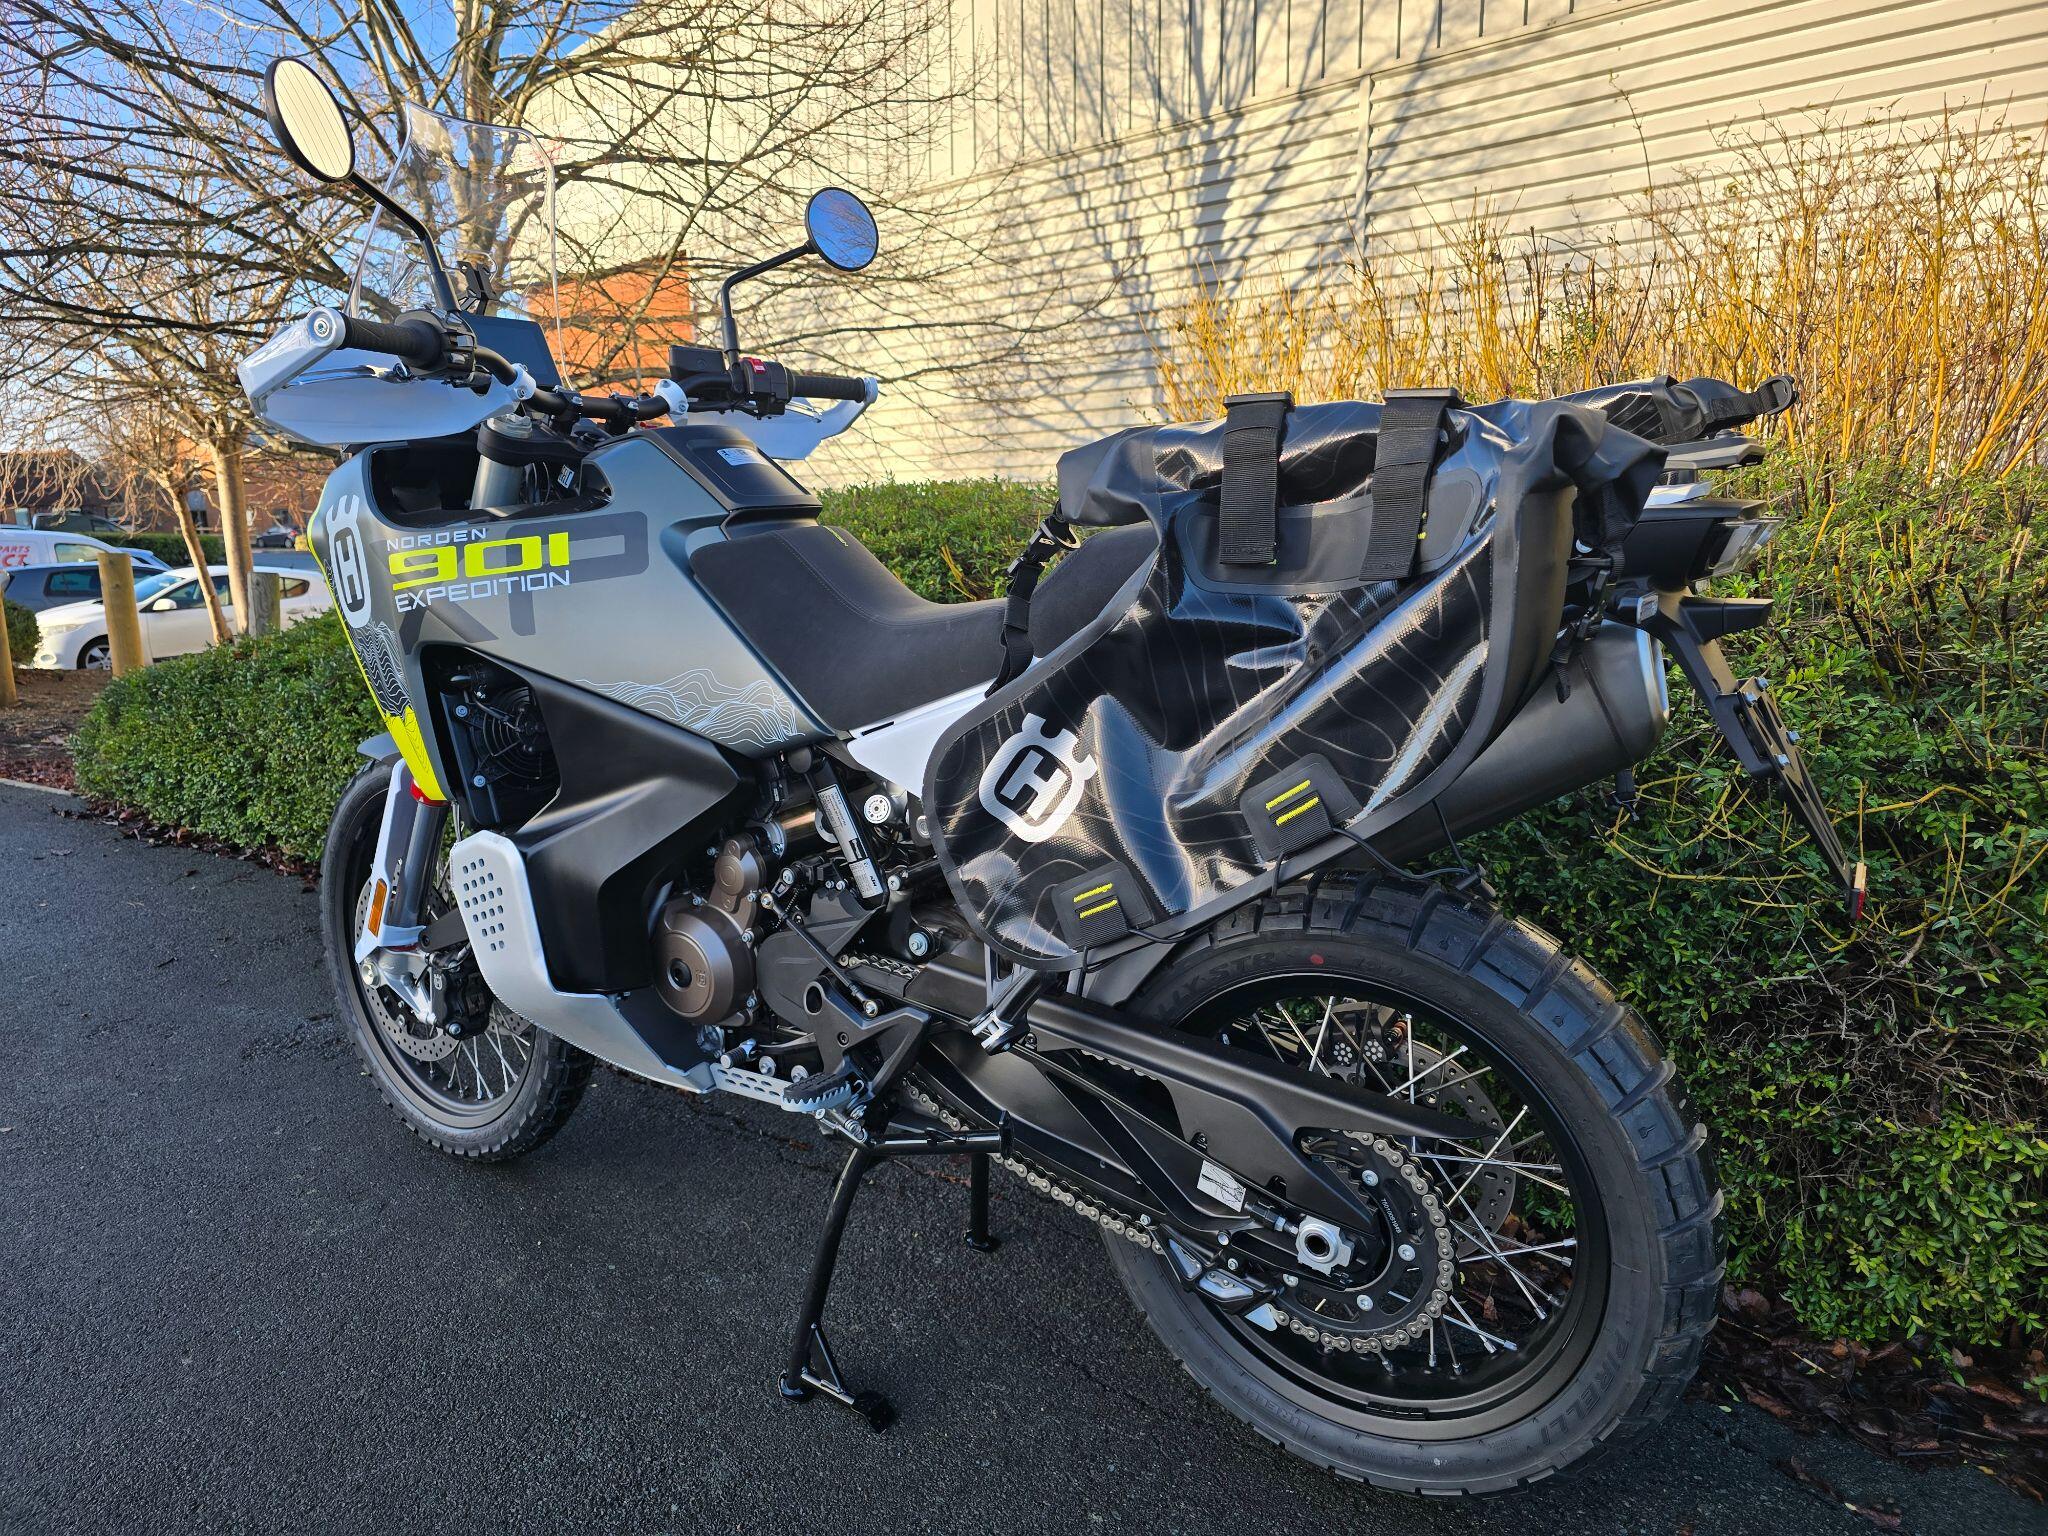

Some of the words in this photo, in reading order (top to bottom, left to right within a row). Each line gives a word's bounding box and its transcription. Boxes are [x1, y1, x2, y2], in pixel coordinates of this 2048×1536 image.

[386, 527, 488, 551] NORDEN
[388, 532, 570, 591] 901
[394, 569, 570, 614] EXPEDITION
[1540, 1329, 1630, 1446] PIRELLI
